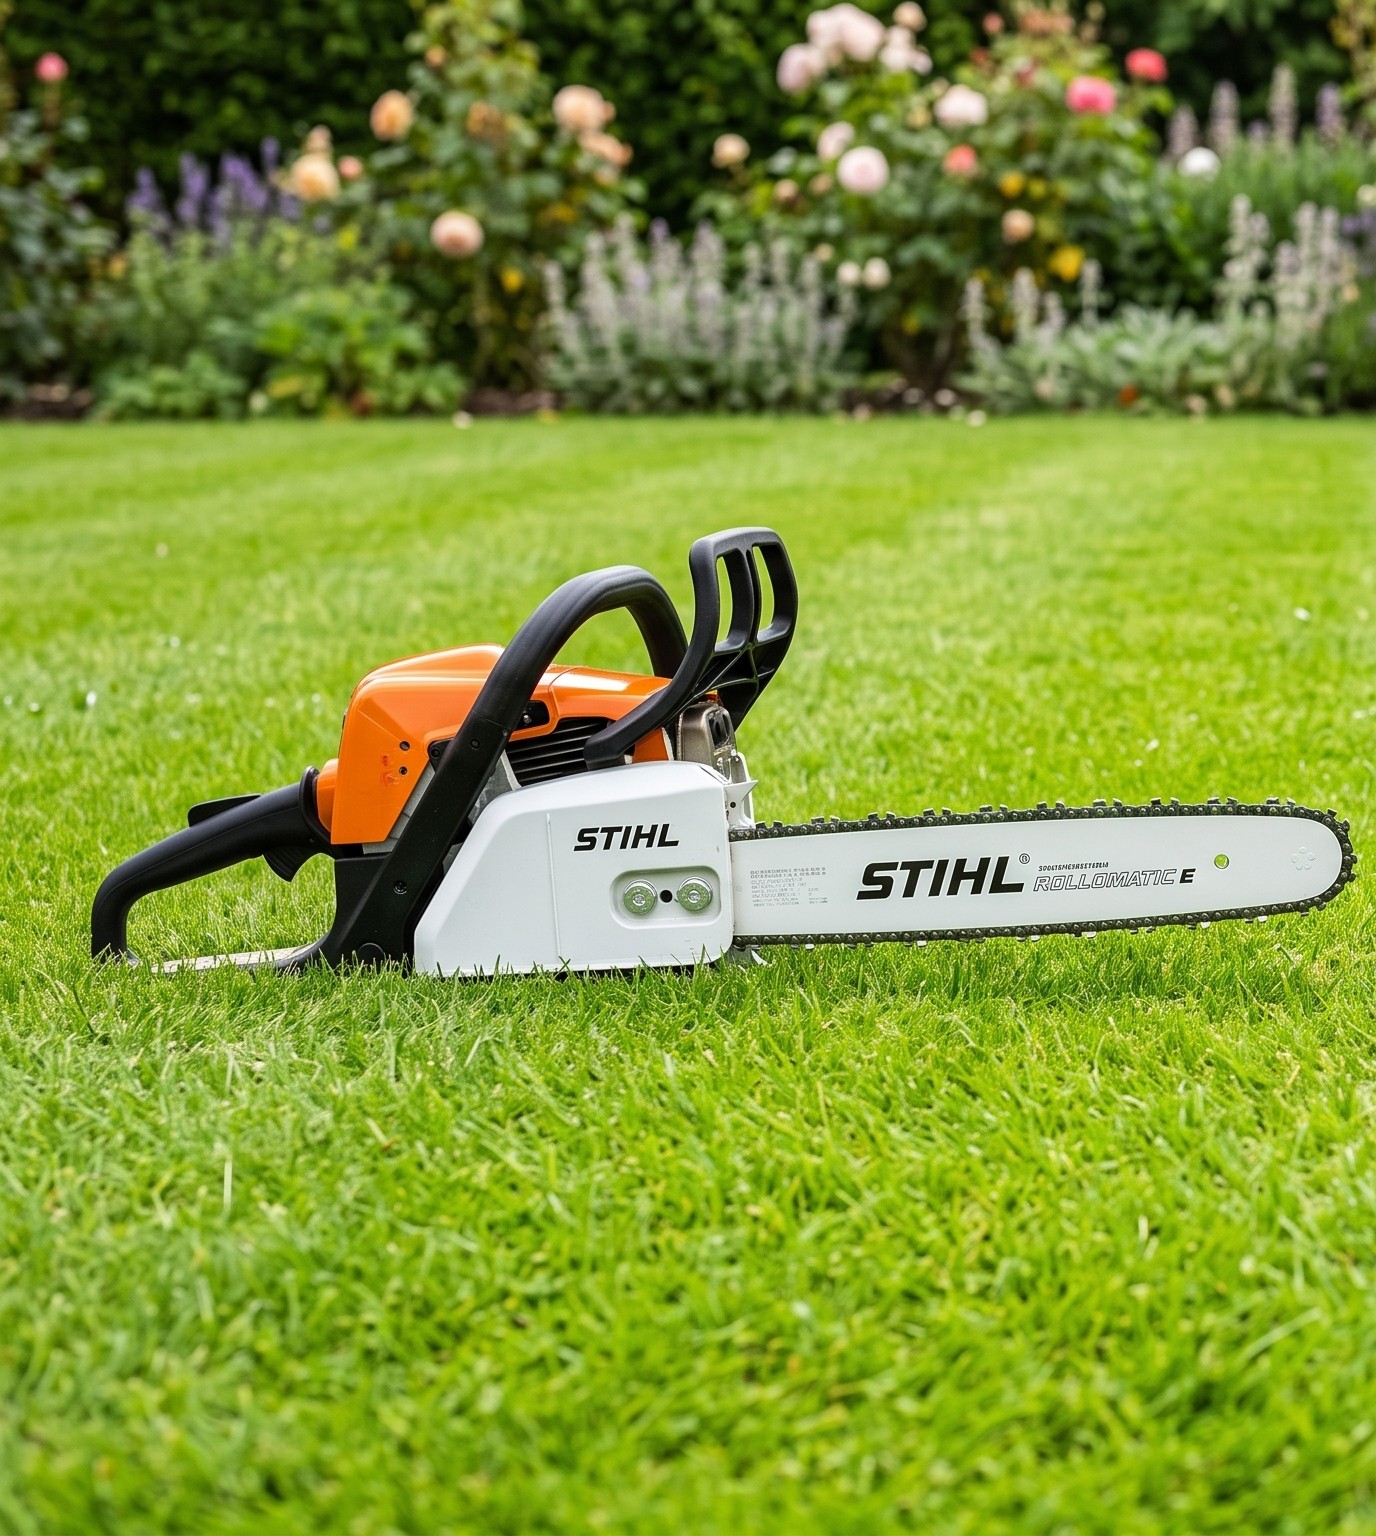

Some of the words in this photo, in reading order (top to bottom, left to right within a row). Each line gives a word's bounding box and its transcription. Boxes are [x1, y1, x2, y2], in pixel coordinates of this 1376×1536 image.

[573, 823, 680, 852] STIHL
[856, 854, 1025, 901] STIHL
[1032, 868, 1178, 892] ROLLOMATIC
[1179, 868, 1197, 884] E
